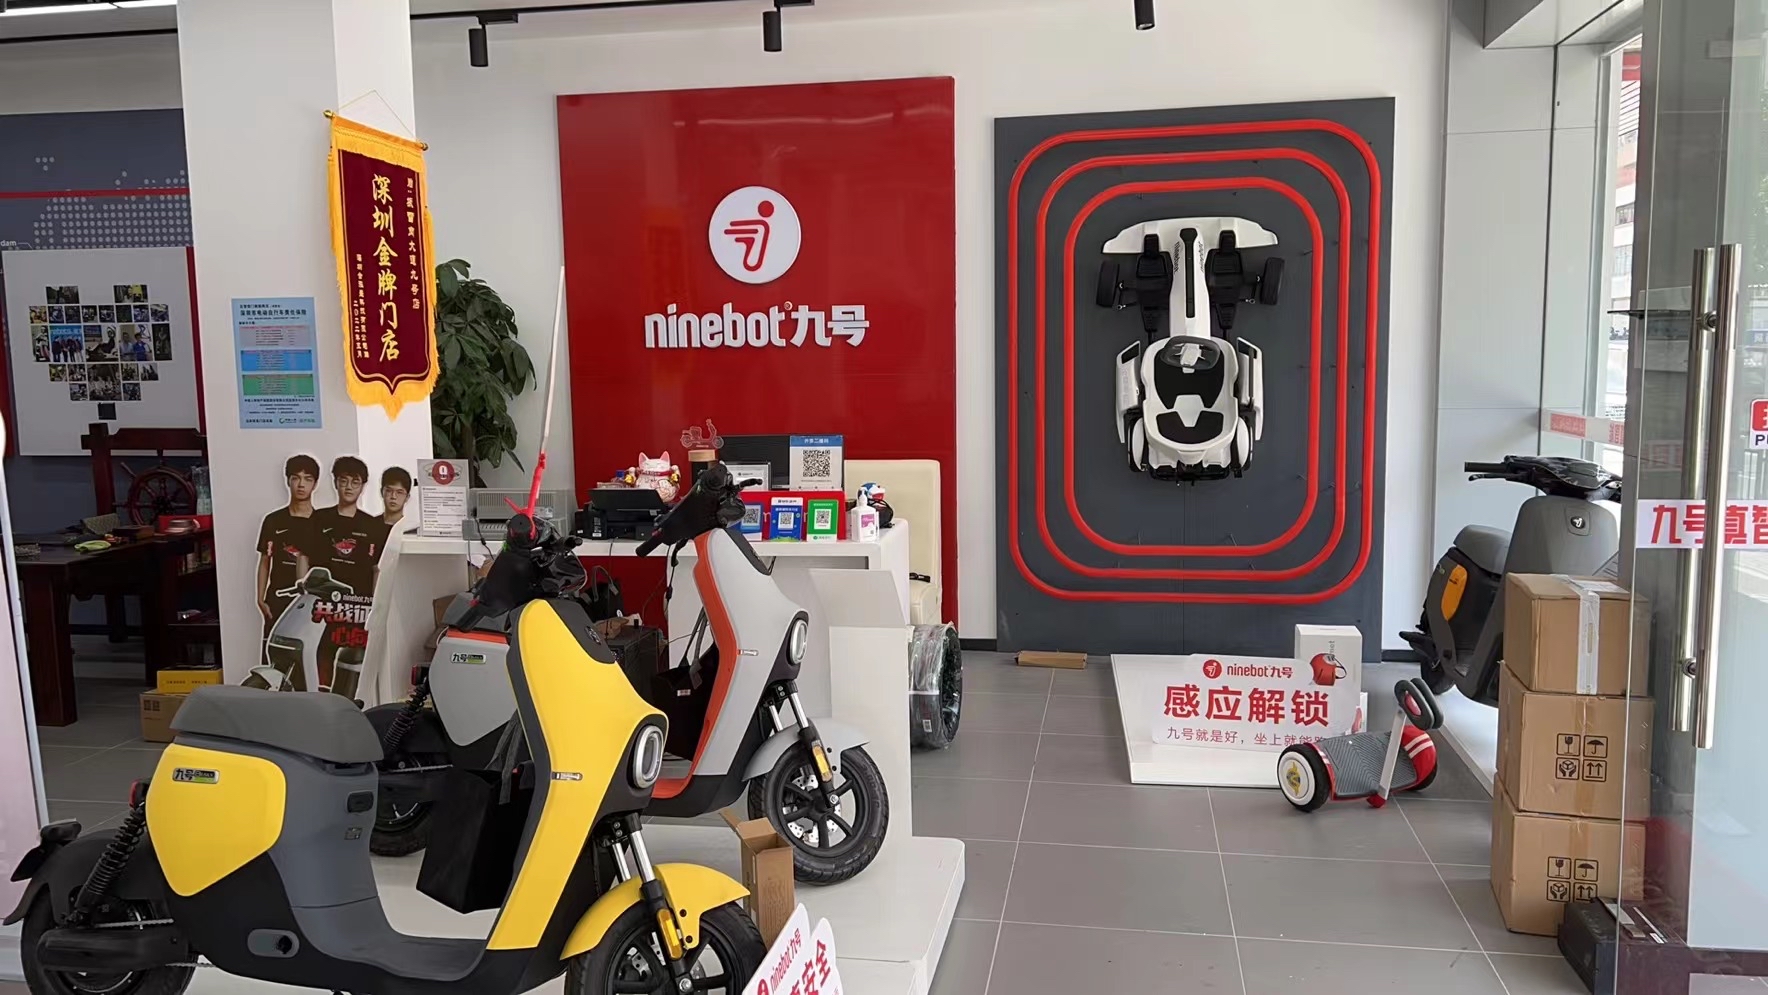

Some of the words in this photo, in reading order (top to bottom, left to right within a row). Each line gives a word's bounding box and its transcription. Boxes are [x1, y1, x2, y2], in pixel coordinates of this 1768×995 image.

[372, 173, 399, 361] 深圳金牌门店
[452, 653, 467, 662] 九号
[1163, 683, 1329, 727] 感应解锁
[174, 768, 194, 781] 九号
